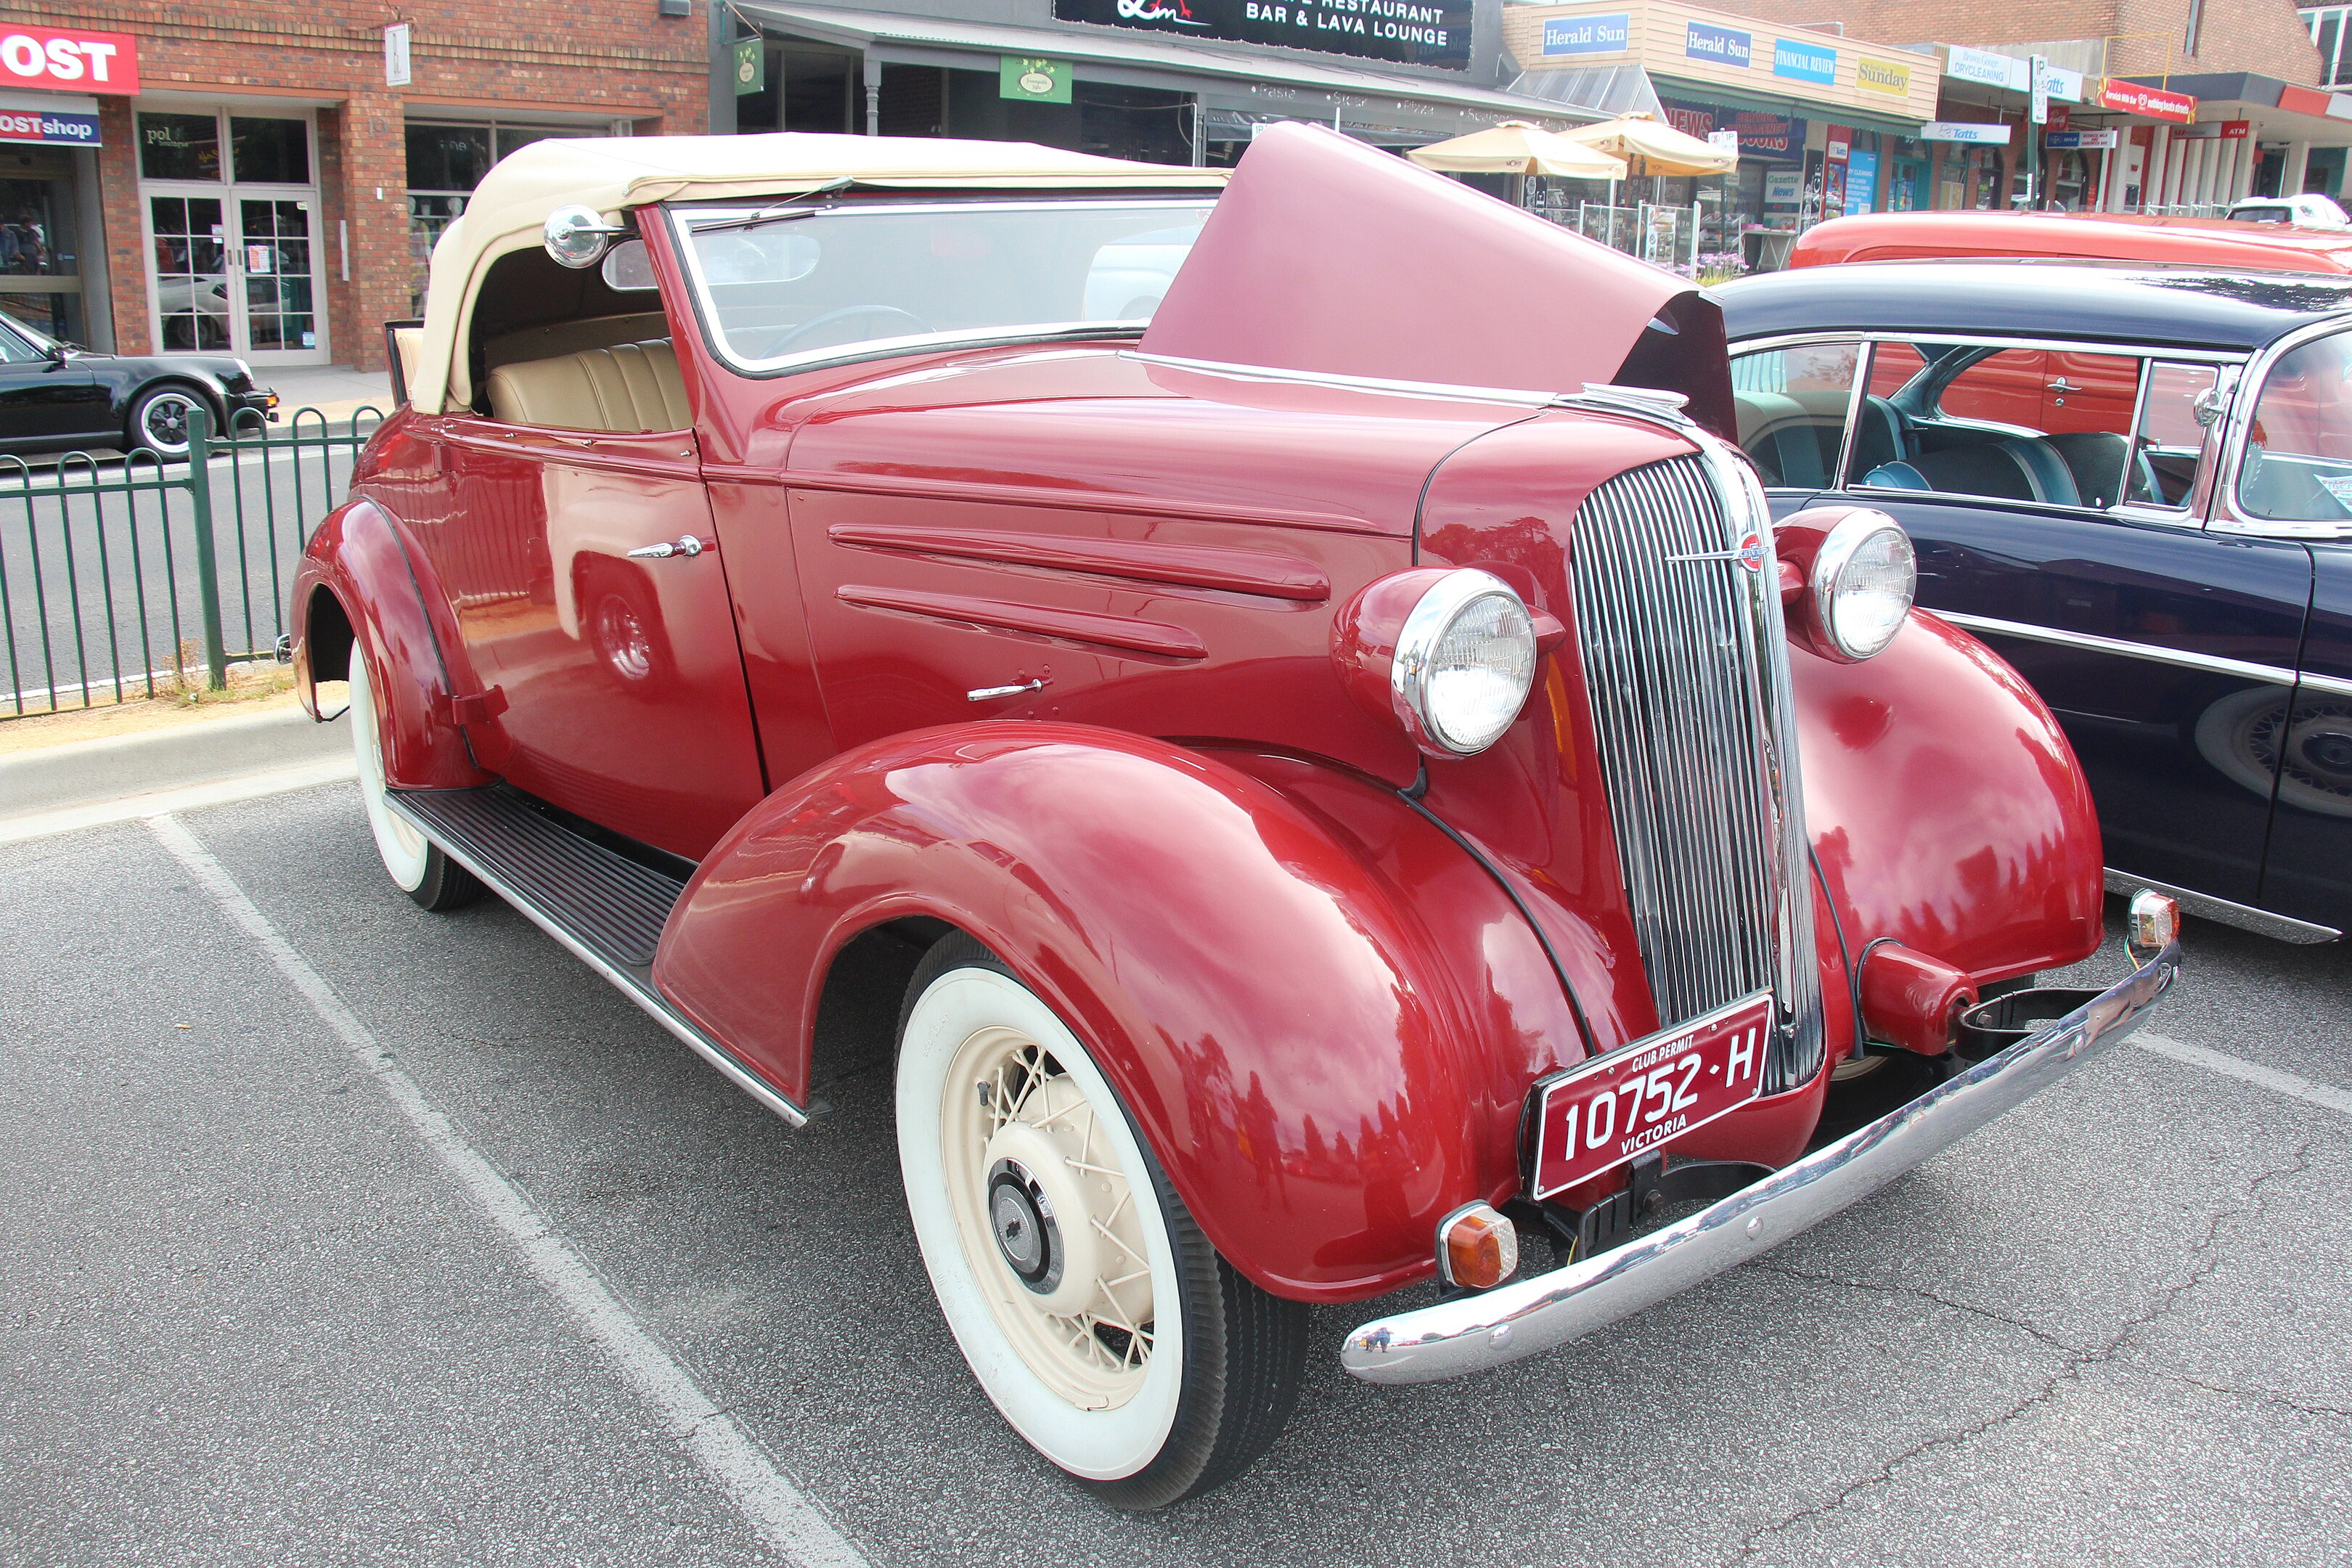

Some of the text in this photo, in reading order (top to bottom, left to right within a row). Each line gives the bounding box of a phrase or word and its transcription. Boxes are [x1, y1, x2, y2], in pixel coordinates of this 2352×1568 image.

[1246, 2, 1287, 23] BAR
[1296, 9, 1308, 26] &
[1318, 12, 1365, 34] LAVA
[1374, 20, 1447, 46] LOUNGE
[1545, 25, 1625, 45] Herald Sun
[1688, 30, 1749, 58] Herald Sun
[0, 35, 116, 81] OST
[1776, 49, 1836, 75] FINANCIAL REVIEW
[1858, 62, 1908, 91] Sunday
[1954, 62, 2004, 82] DRYCLEANING
[2046, 75, 2065, 94] atts
[146, 126, 171, 144] pol
[1953, 128, 1979, 139] Tatts
[1768, 174, 1800, 184] Gazette
[1772, 187, 1794, 197] News
[1632, 1034, 1694, 1073] CLUB PERMIT
[1621, 1113, 1686, 1155] VICTORIA
